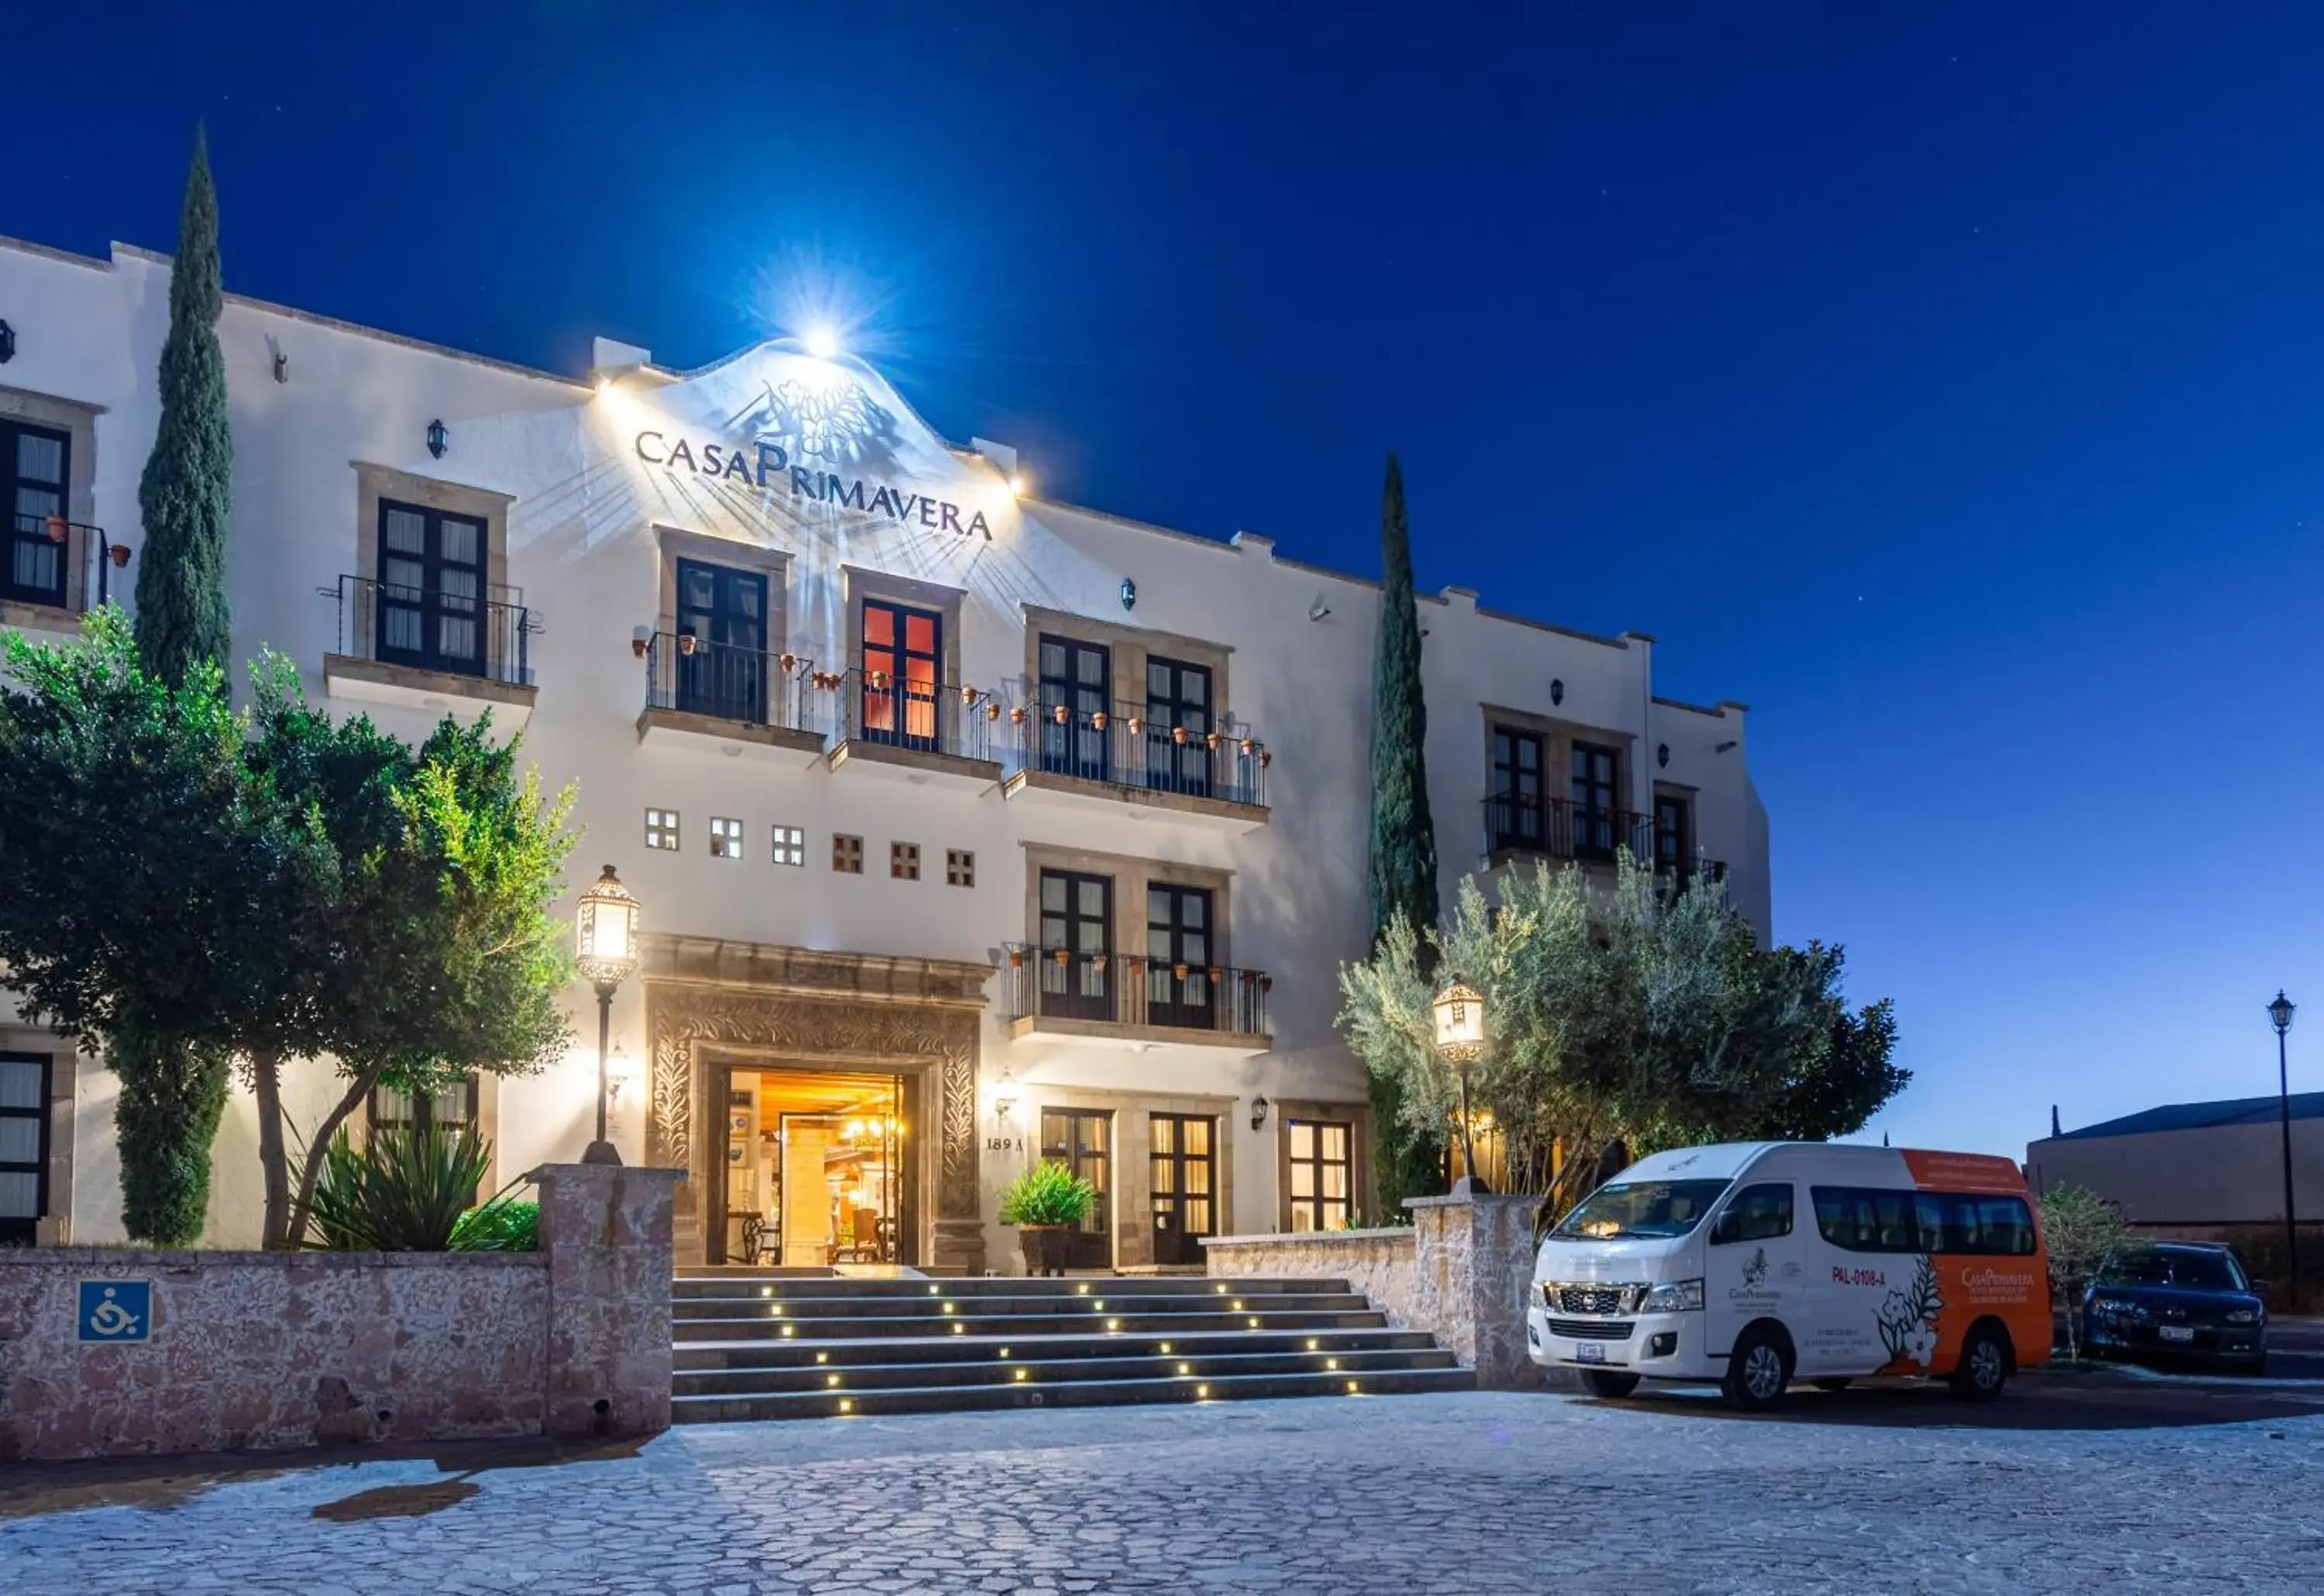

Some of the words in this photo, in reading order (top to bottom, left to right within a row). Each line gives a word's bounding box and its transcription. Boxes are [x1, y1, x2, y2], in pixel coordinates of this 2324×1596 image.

[635, 432, 992, 541] CASAPRIMAVERA
[987, 1138, 1011, 1151] 189
[1016, 1138, 1023, 1152] A
